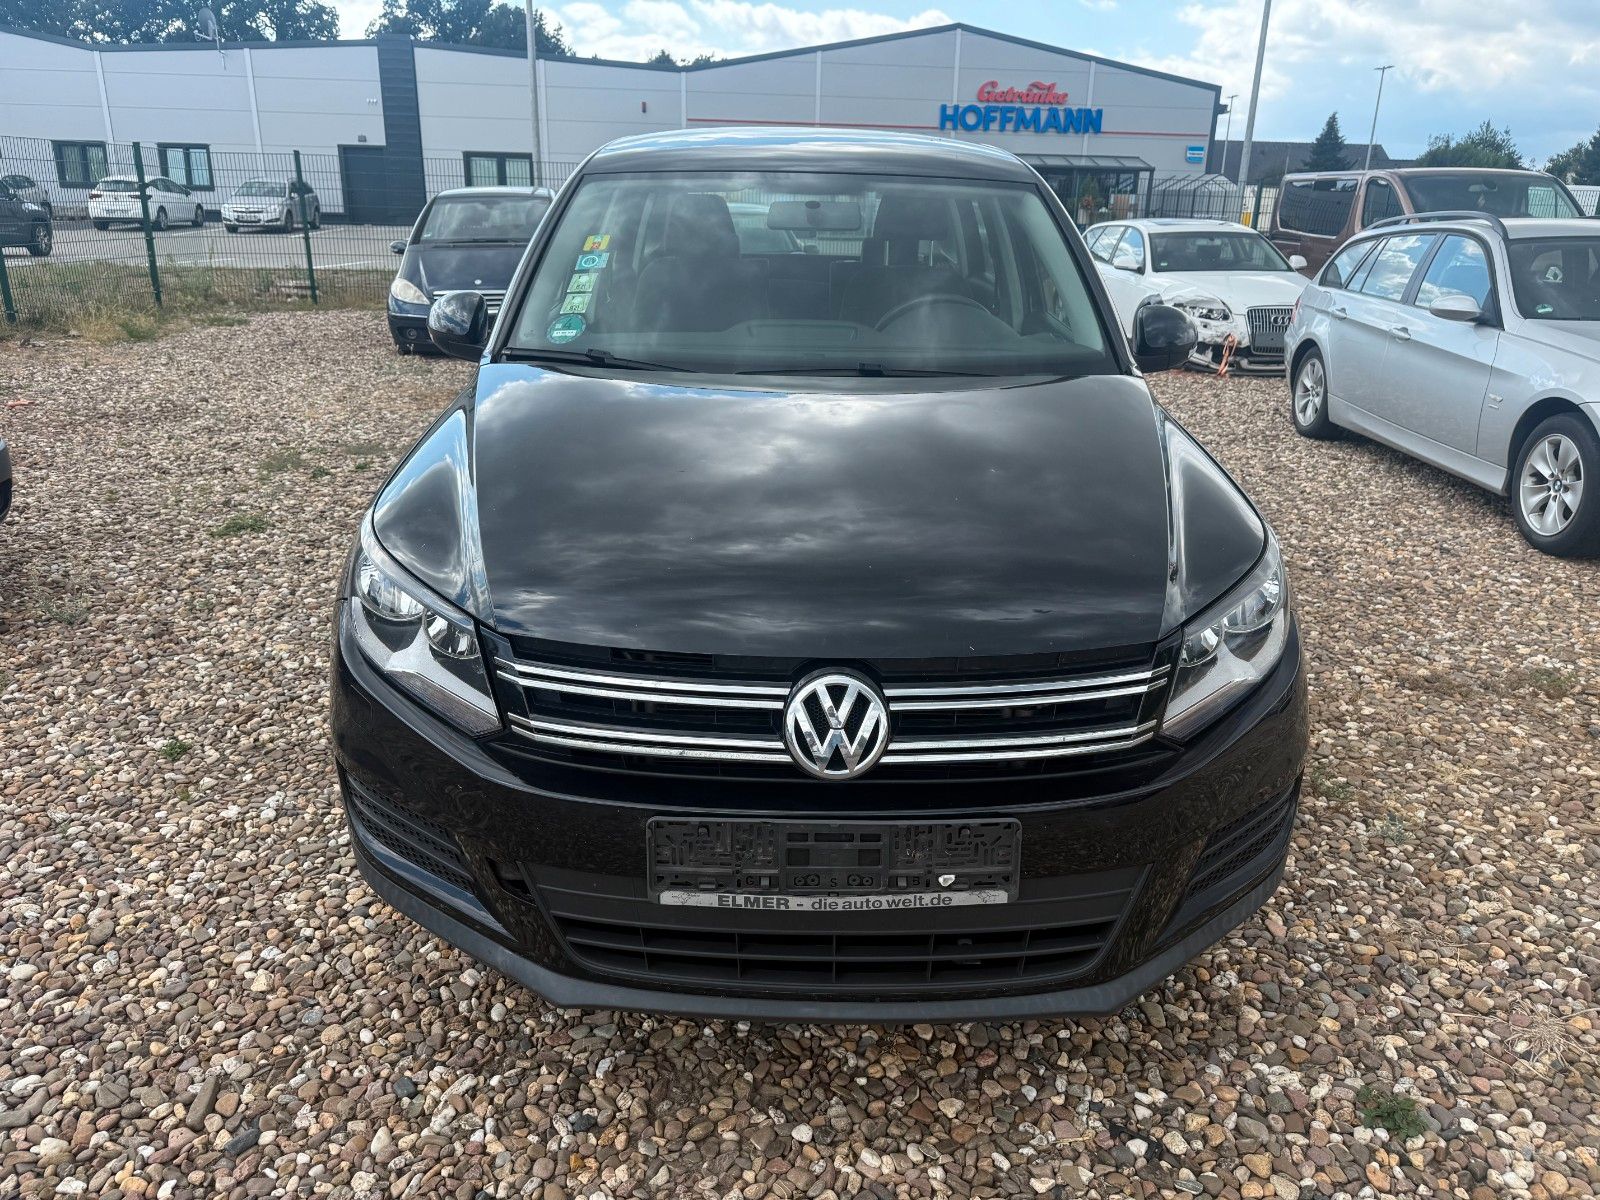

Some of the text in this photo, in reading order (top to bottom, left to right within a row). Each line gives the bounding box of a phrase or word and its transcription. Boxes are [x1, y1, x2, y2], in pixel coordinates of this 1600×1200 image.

[939, 104, 1103, 134] HOFFMANN
[786, 675, 888, 778] VW
[717, 894, 790, 910] ELMER
[811, 898, 838, 910] die
[841, 899, 883, 910] auto
[885, 893, 953, 909] welt.de
